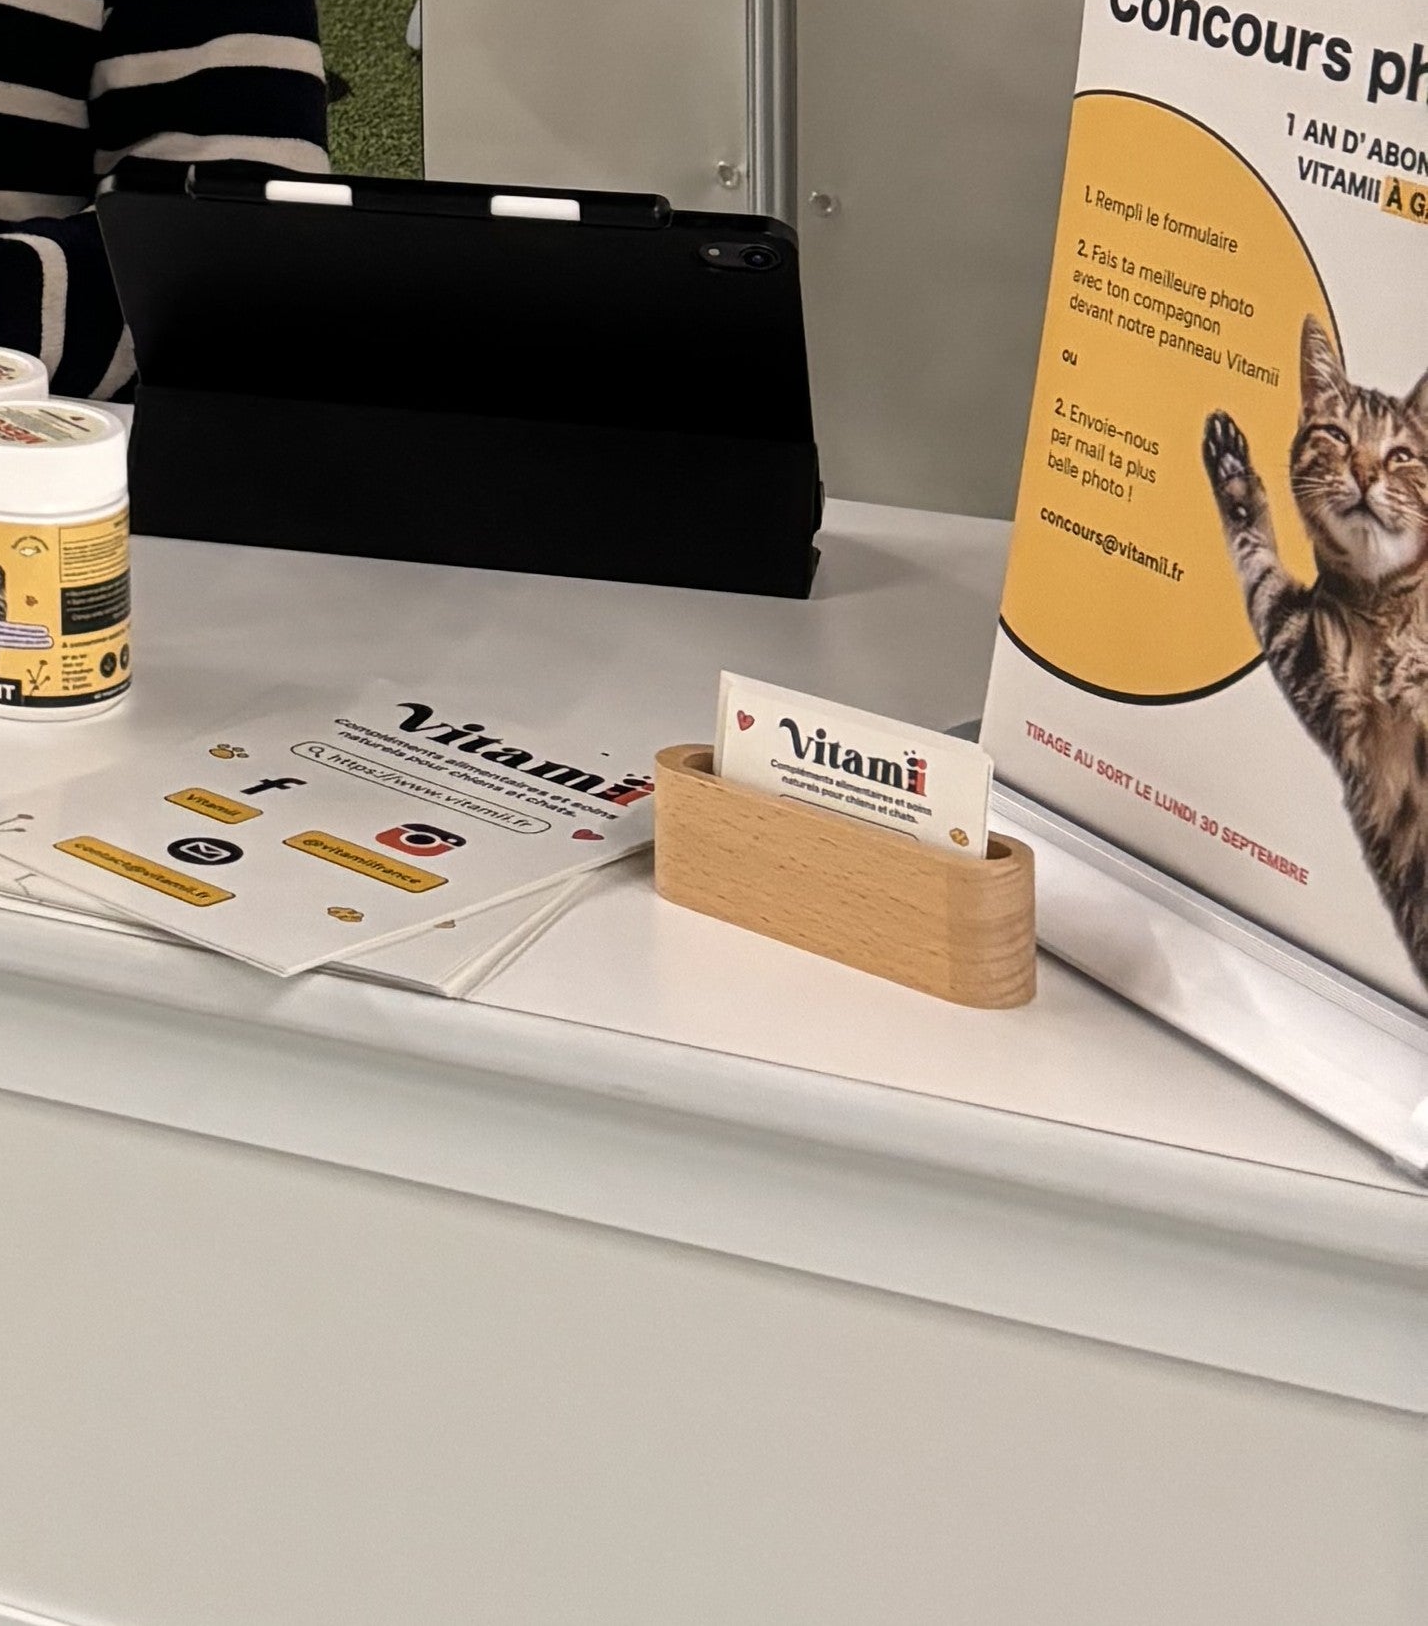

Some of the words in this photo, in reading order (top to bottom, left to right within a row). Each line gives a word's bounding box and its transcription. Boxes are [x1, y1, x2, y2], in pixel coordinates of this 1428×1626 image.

[1297, 156, 1381, 205] VITAMII
[1095, 191, 1142, 223] Rempli
[1147, 206, 1159, 228] le
[1163, 212, 1238, 253] formulaire
[1073, 270, 1102, 291] avec
[1107, 278, 1129, 301] ton
[1133, 290, 1221, 336] compagnon
[1091, 245, 1118, 270] Fais
[1121, 256, 1135, 275] ta
[1139, 262, 1207, 301] meilleure
[1210, 288, 1255, 318] photo
[1069, 294, 1113, 324] devant
[1118, 310, 1156, 339] notre
[1159, 327, 1221, 365] panneau
[1226, 350, 1280, 387] Vitamii
[1040, 506, 1184, 582] concours@vitamii.fr
[1025, 720, 1072, 759] TIRAGE
[1074, 745, 1094, 770] AU
[1095, 755, 1133, 788] SORT
[1134, 776, 1152, 801] LE
[1154, 787, 1197, 829] LUNDI
[1200, 814, 1219, 837] 30
[1222, 825, 1309, 885] SEPTEMBRE
